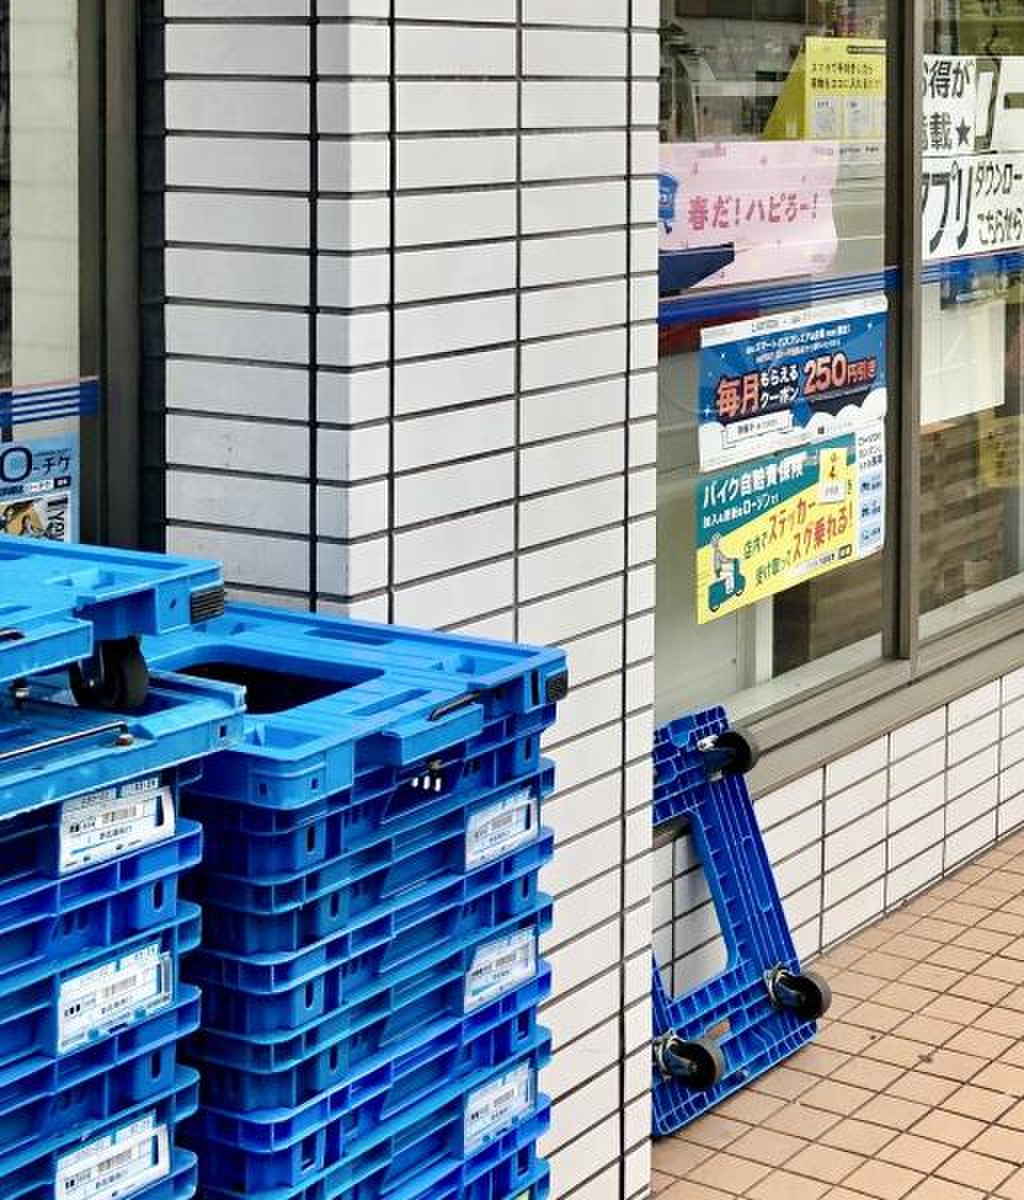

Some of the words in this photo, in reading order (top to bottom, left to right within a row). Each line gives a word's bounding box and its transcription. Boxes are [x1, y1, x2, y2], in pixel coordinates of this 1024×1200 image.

[760, 364, 799, 386] もらえる
[718, 372, 759, 416] 毎月
[760, 386, 799, 408] クーポン
